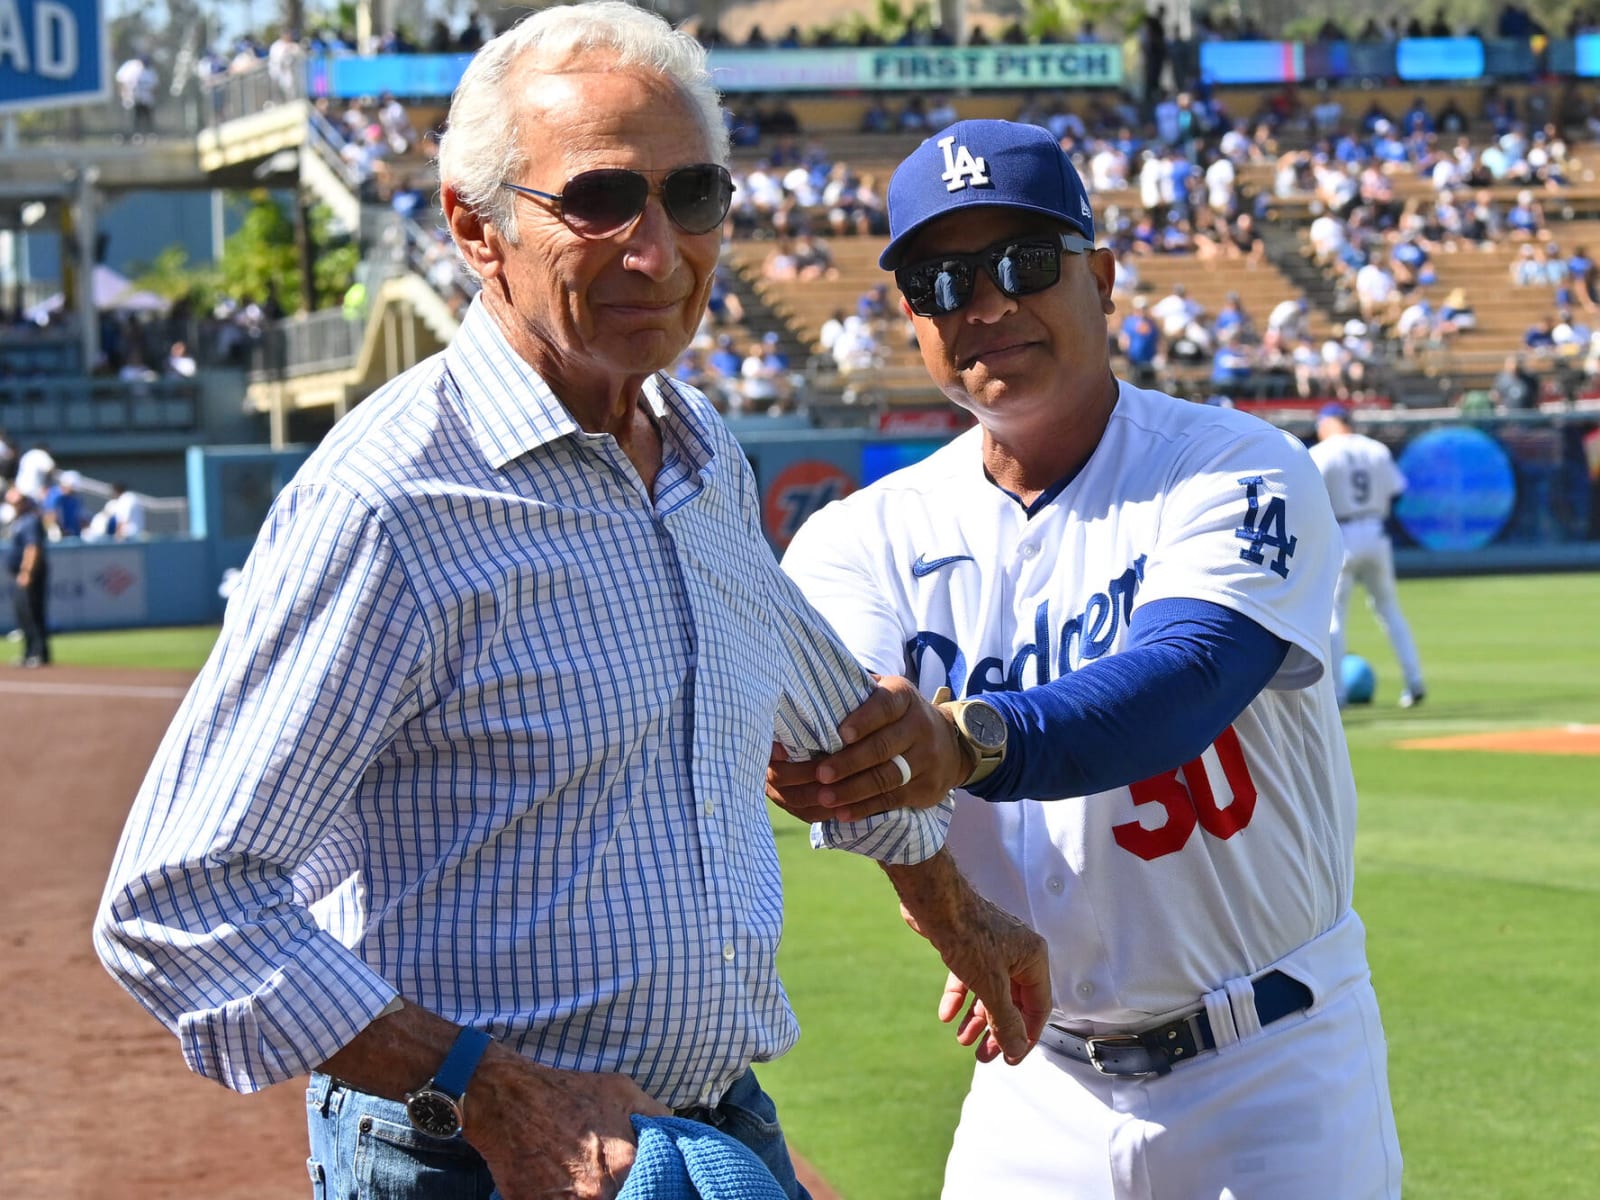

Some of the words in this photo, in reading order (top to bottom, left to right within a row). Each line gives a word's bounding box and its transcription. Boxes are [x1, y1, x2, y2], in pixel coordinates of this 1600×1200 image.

[873, 53, 981, 78] FIRST
[994, 50, 1111, 78] PITCH
[937, 136, 988, 192] LA
[1350, 469, 1371, 504] 9
[1235, 474, 1298, 579] LA
[1113, 724, 1258, 862] 30
